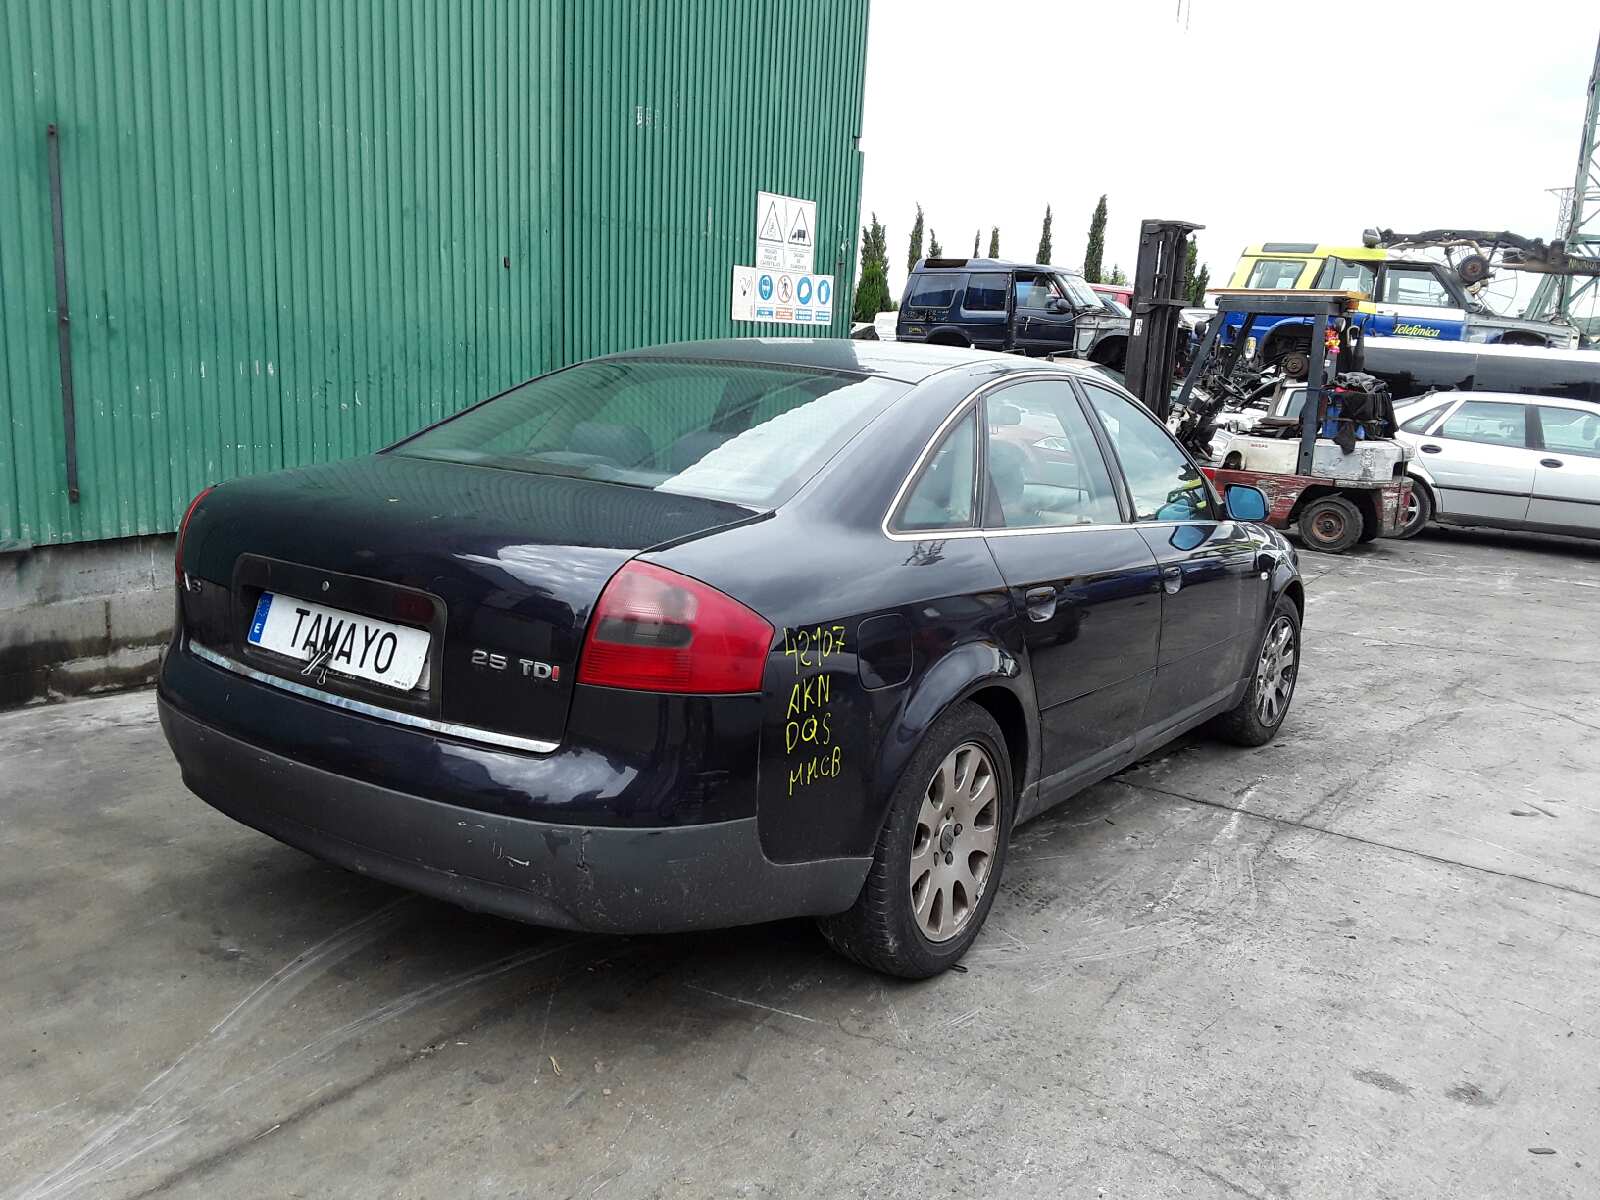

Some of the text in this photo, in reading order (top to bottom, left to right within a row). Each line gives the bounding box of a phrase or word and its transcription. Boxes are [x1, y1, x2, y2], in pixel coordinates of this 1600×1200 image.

[254, 607, 398, 674] E TAMAYO
[783, 625, 846, 675] 42107
[471, 649, 560, 682] 25 TDI
[786, 674, 831, 720] AKN
[786, 712, 832, 755] DQS
